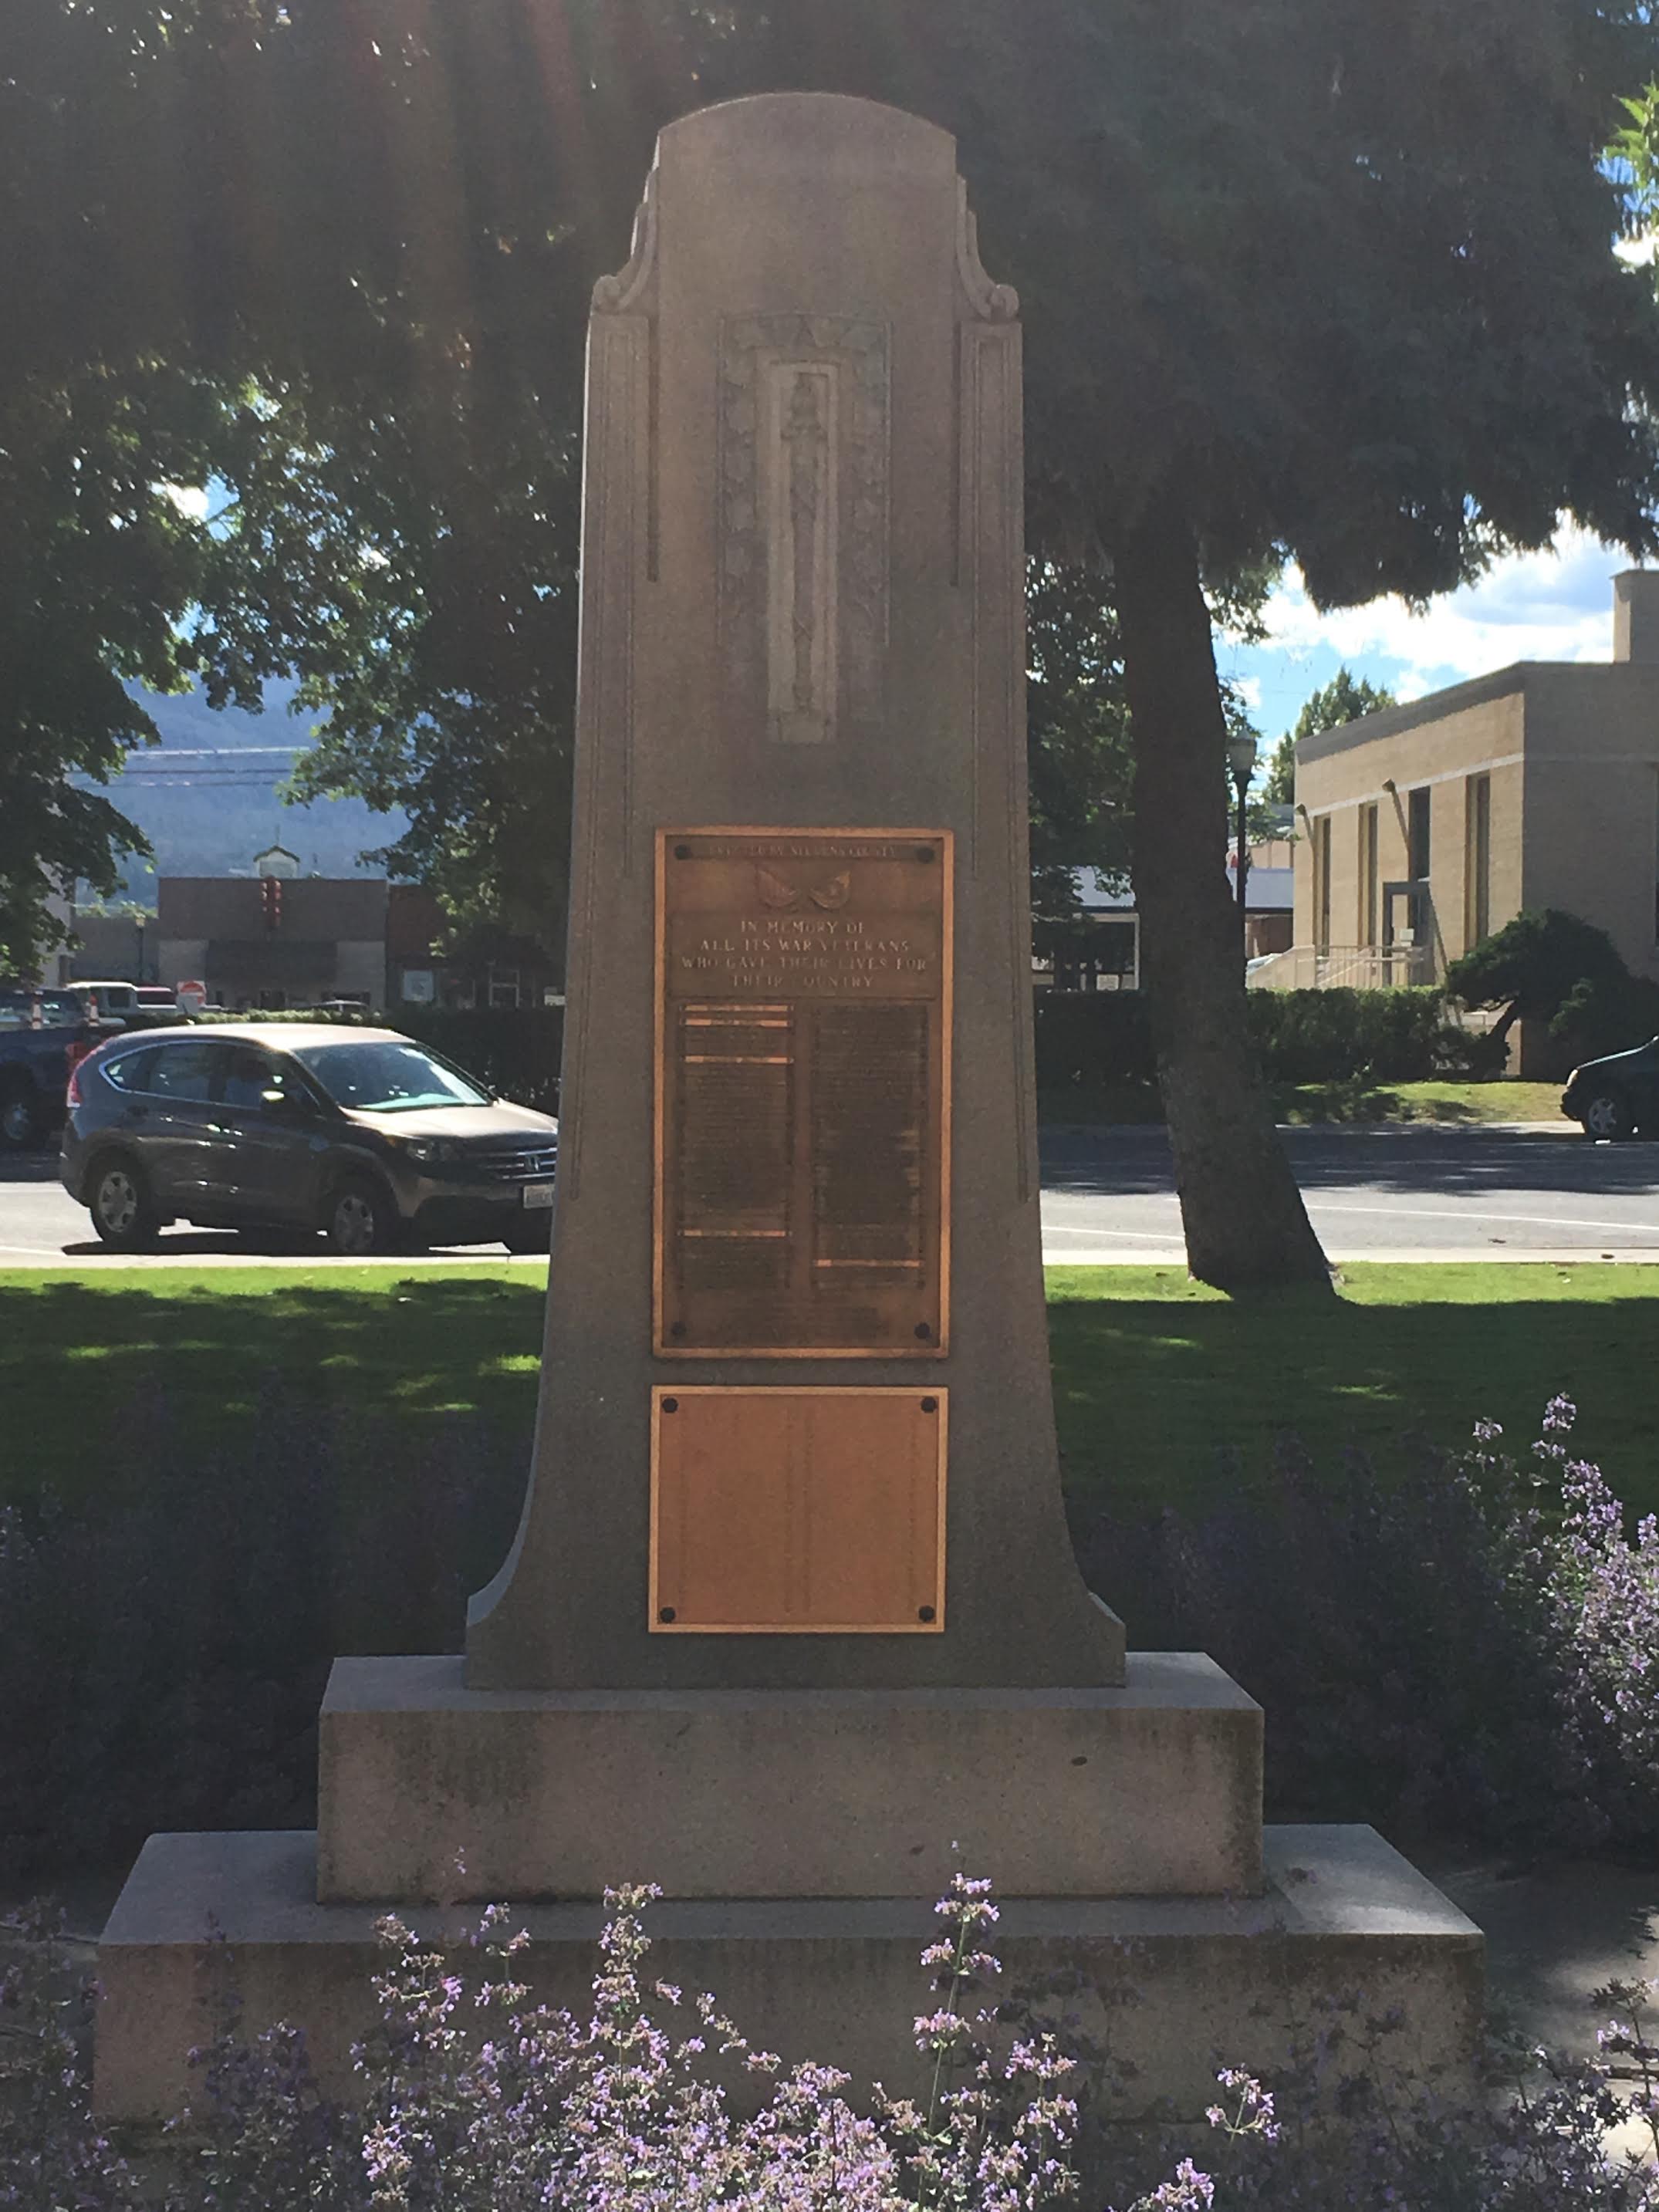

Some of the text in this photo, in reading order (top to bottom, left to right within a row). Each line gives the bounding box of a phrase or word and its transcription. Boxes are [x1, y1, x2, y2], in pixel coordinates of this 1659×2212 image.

[741, 920, 757, 933] IN
[768, 920, 837, 934] MEMORY
[701, 939, 735, 951] ALL
[745, 939, 771, 951] ITS
[779, 939, 811, 951] WAR
[681, 957, 718, 968] WHO
[896, 957, 926, 971] FOR
